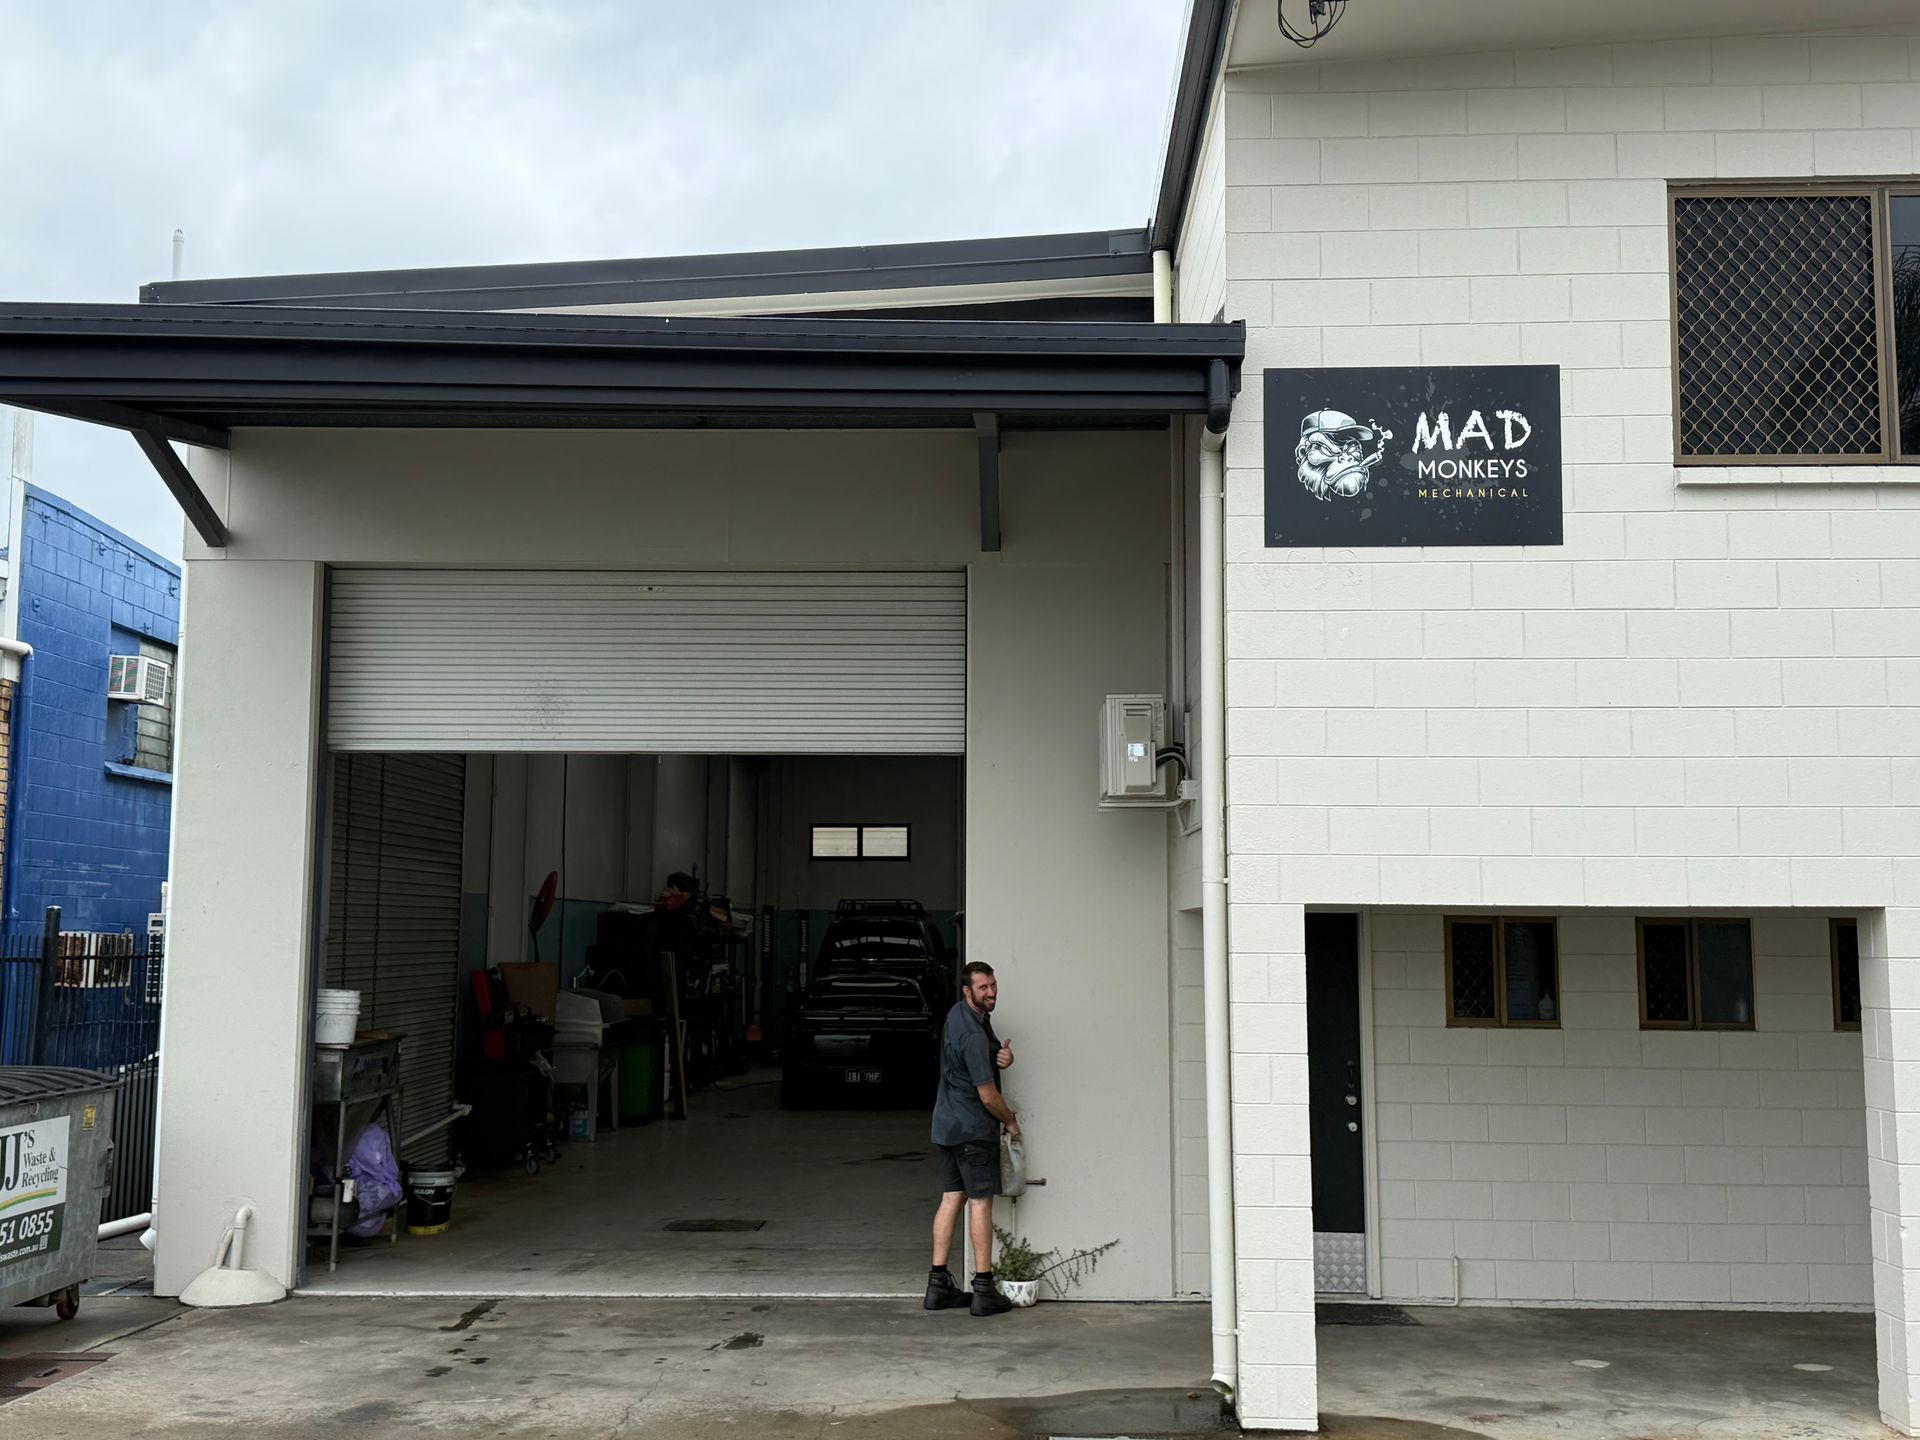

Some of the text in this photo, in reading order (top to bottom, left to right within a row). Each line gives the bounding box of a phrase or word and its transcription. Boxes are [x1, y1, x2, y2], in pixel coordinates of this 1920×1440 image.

[1412, 410, 1532, 454] MAD
[1418, 459, 1528, 479] MONKEYS
[1418, 488, 1529, 498] MECHANICAL
[23, 1146, 56, 1168] Waste &
[22, 1166, 59, 1188] Recycling
[19, 1210, 54, 1241] 0855
